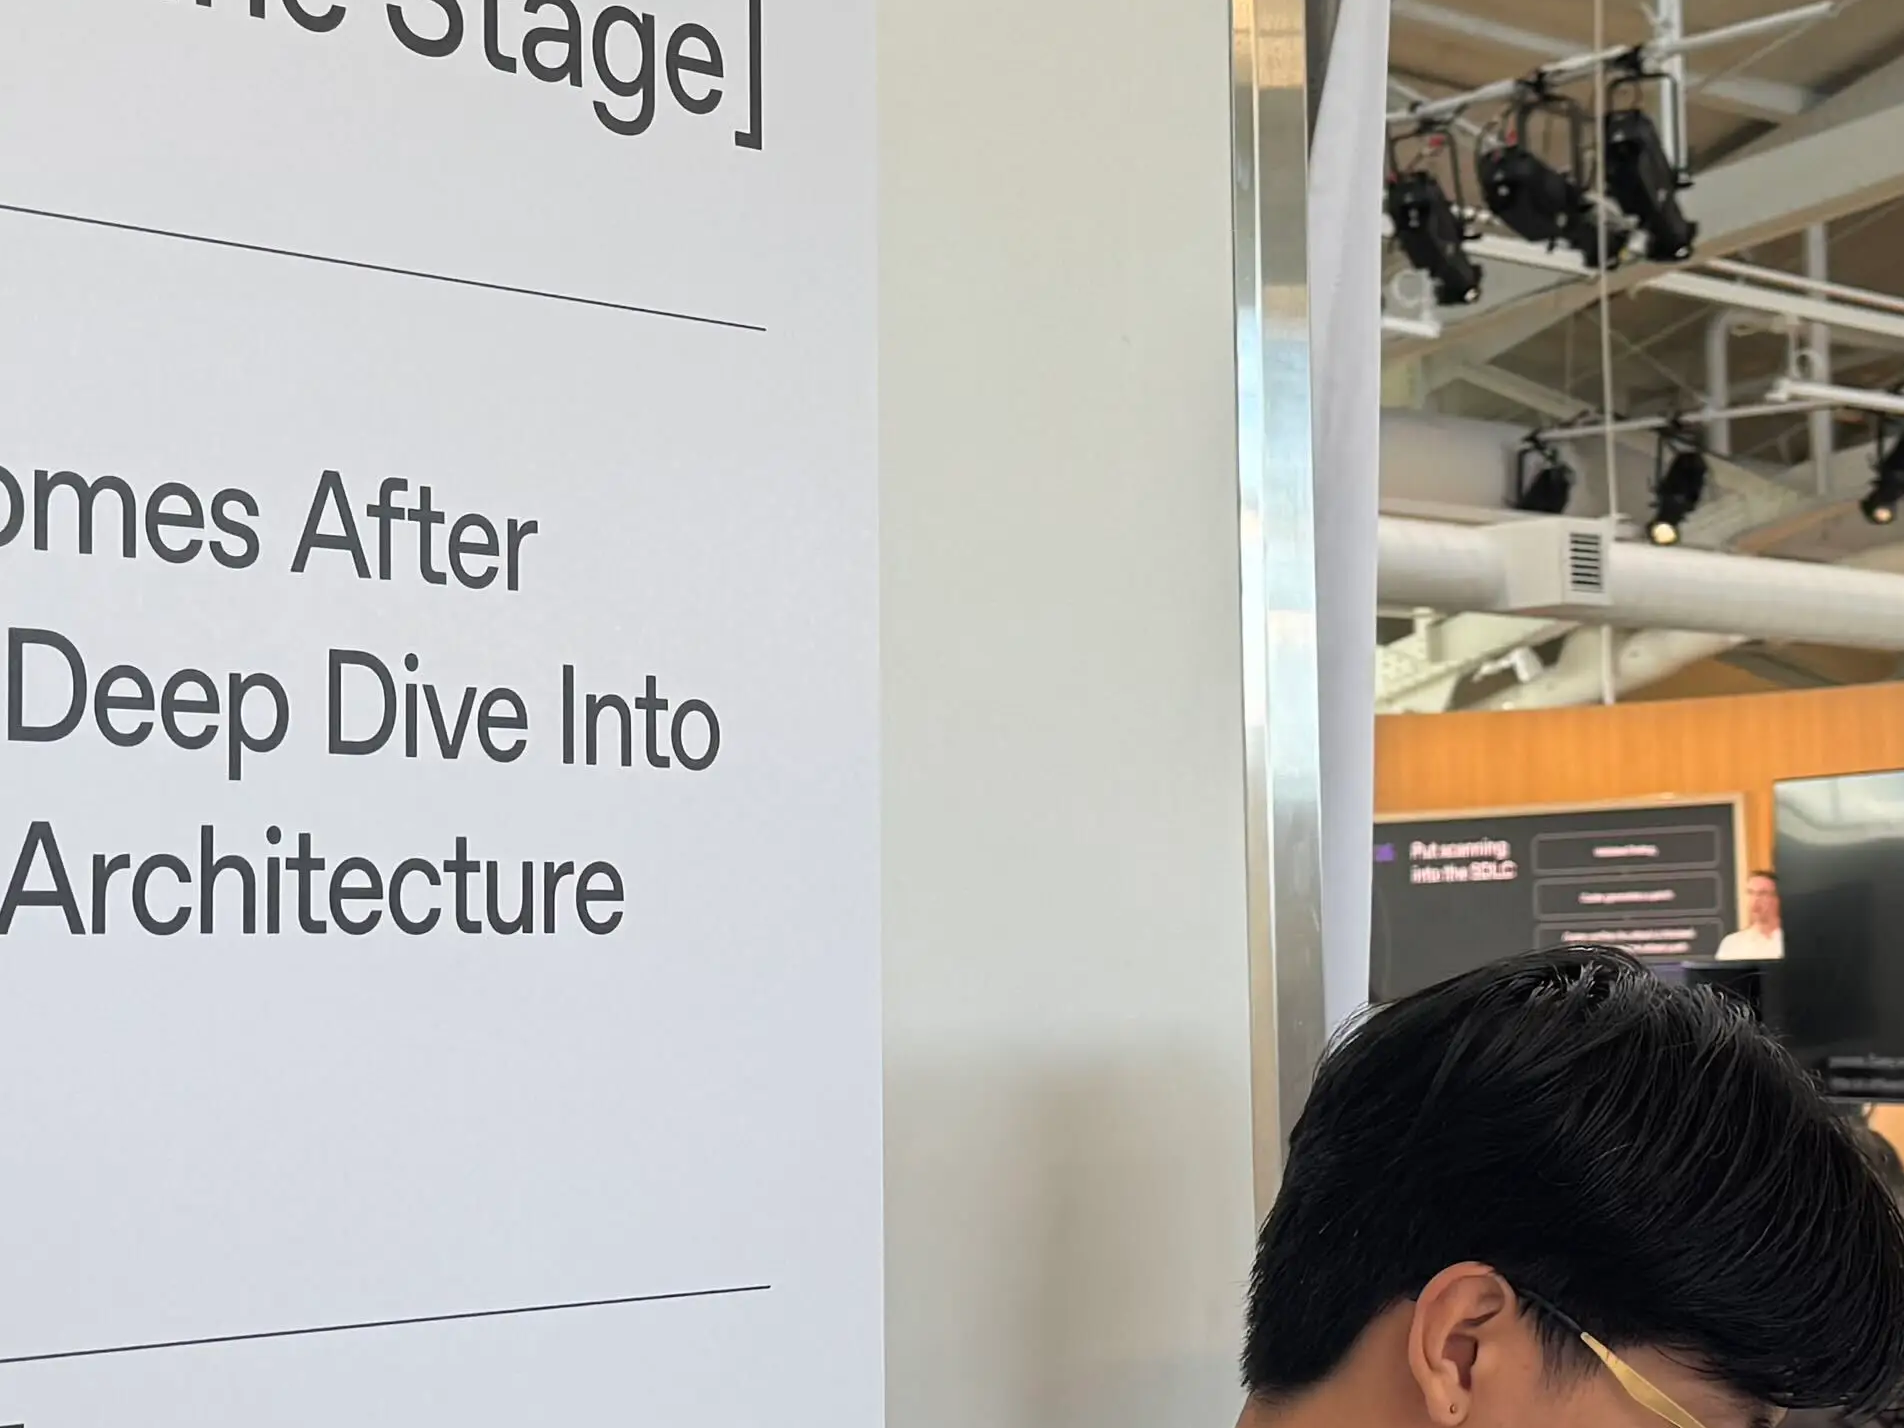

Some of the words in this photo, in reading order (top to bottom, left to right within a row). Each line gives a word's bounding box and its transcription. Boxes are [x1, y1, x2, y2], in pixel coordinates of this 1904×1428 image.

[289, 468, 539, 592] After
[6, 626, 291, 782] Deep
[327, 647, 530, 764] Dive
[561, 663, 722, 772] Into
